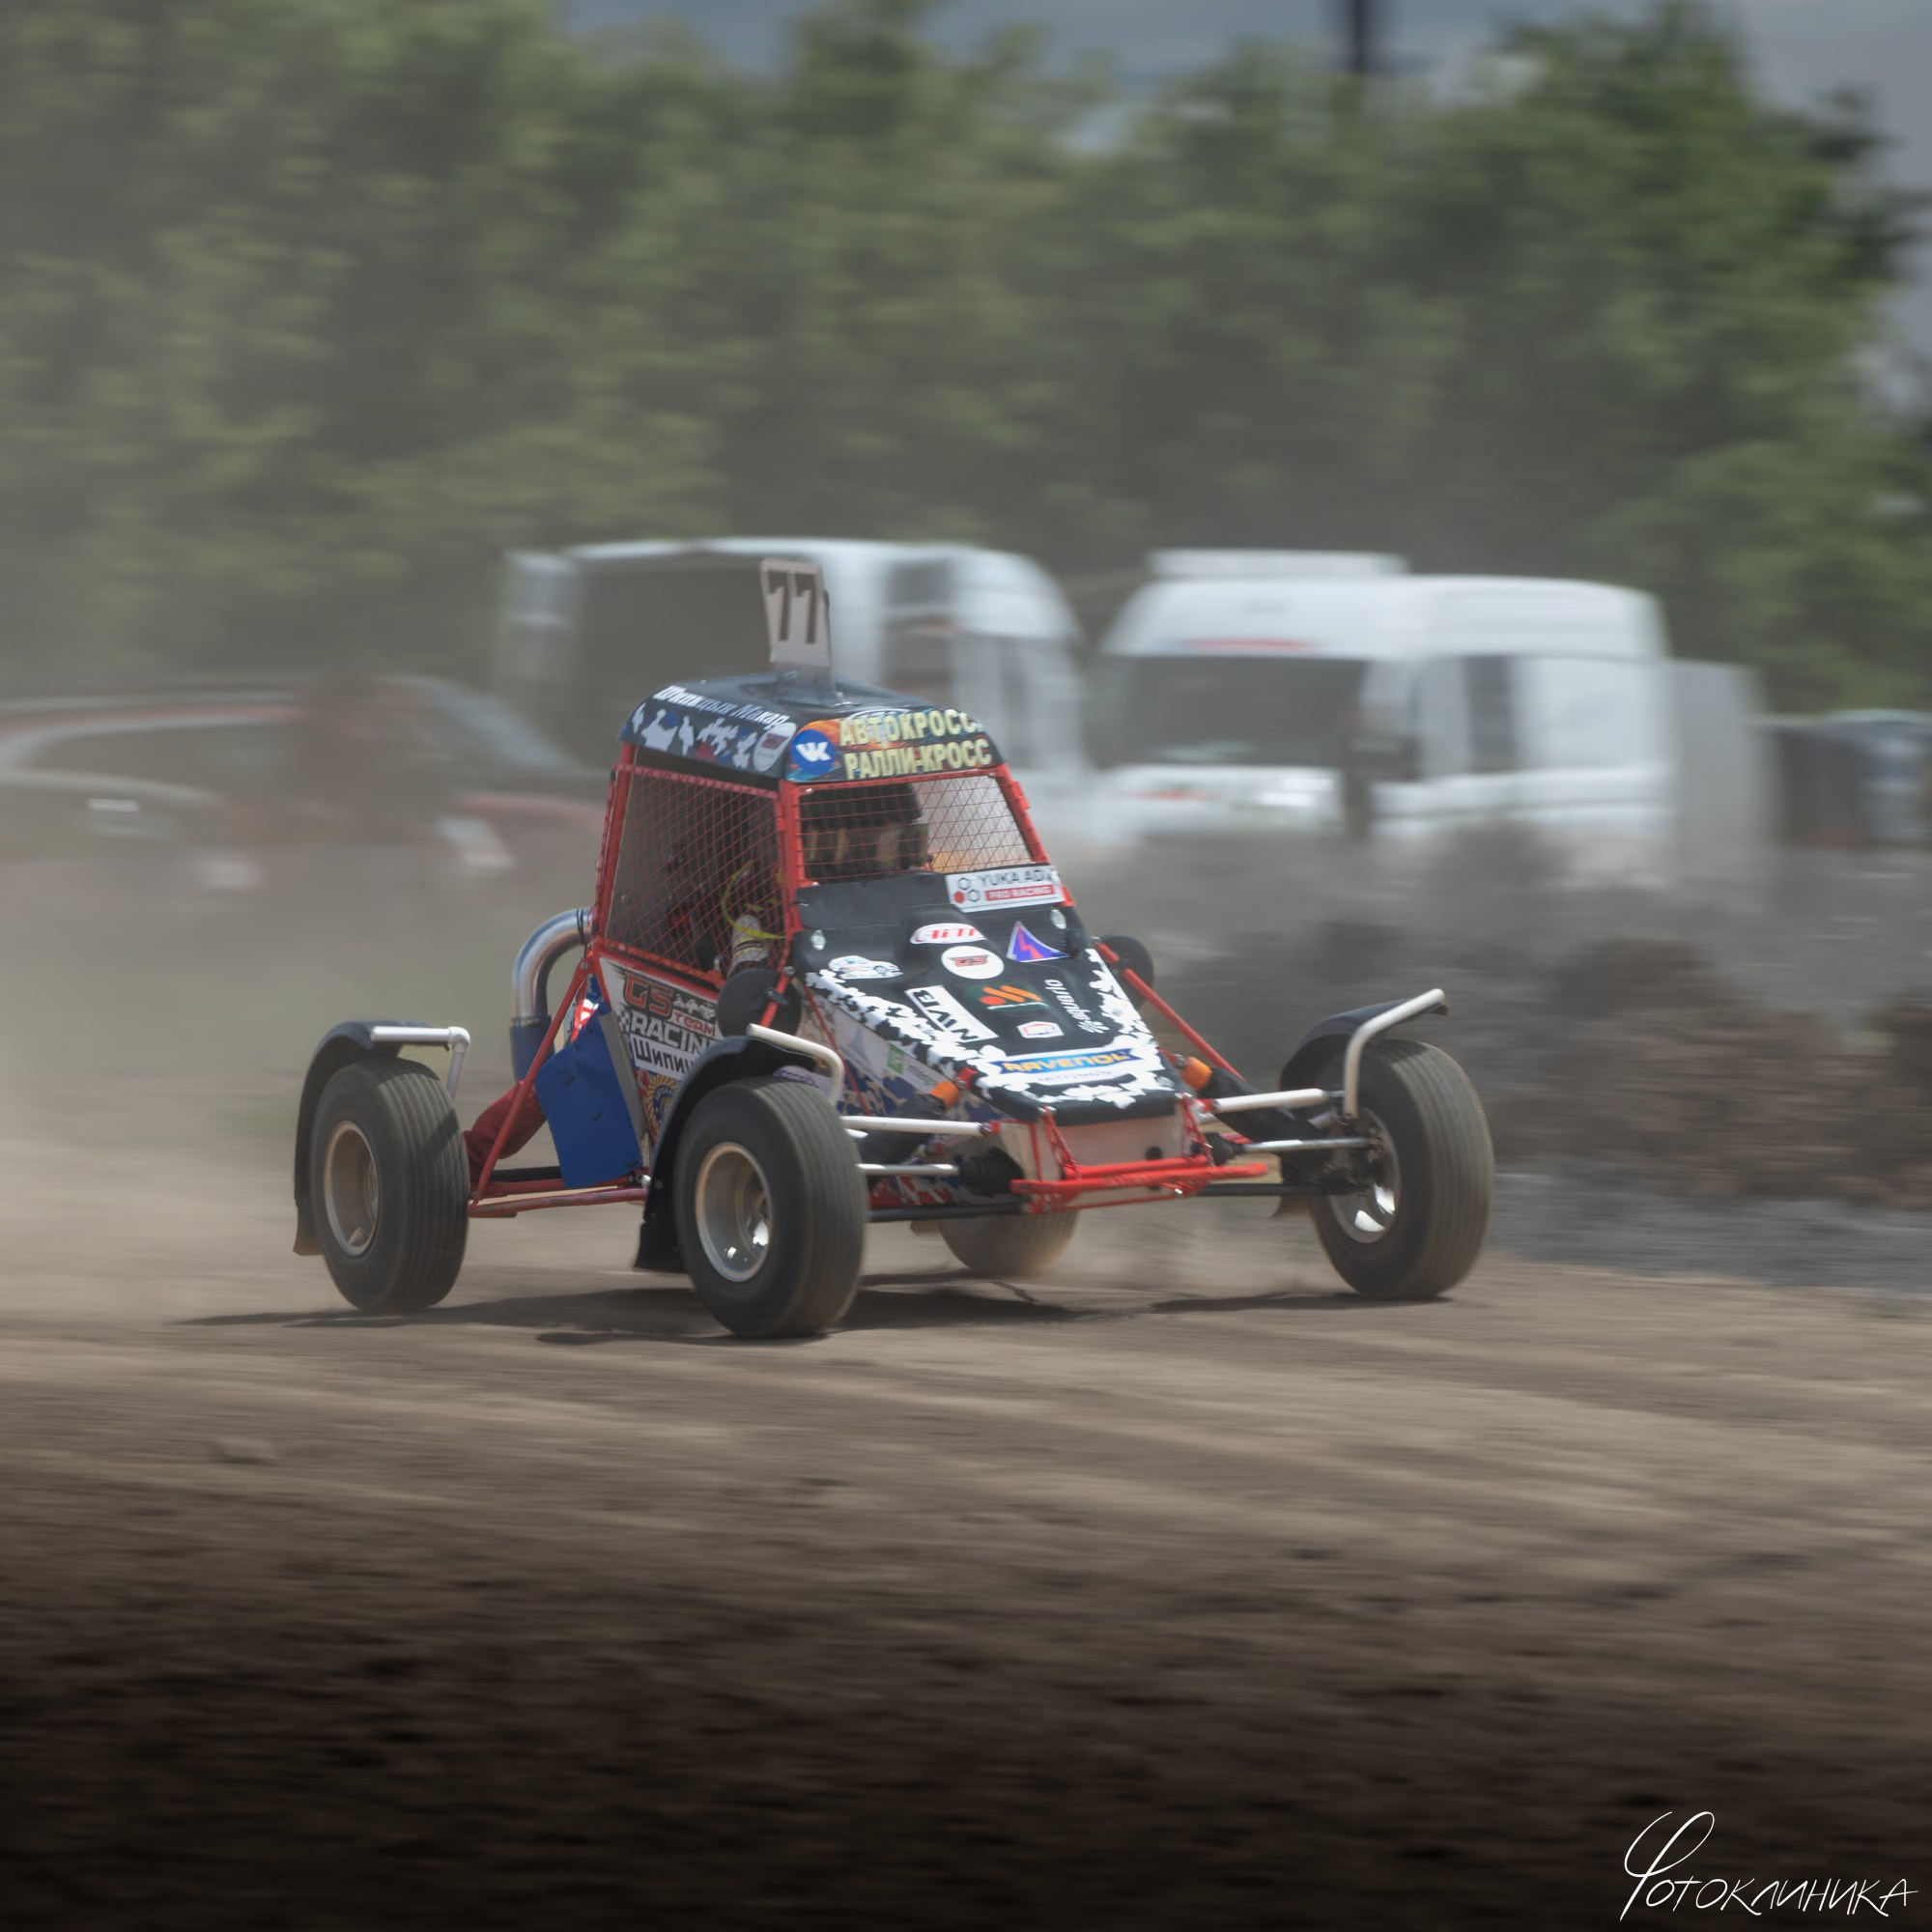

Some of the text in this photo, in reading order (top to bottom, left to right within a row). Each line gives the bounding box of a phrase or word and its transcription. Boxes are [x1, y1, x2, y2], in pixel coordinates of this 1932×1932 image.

[766, 570, 816, 644] 77
[843, 738, 993, 781] РАЛЛИ-КРОСС
[631, 1010, 713, 1056] RACIN
[673, 1010, 716, 1037] TEAM
[1002, 1052, 1129, 1072] RAVENOL
